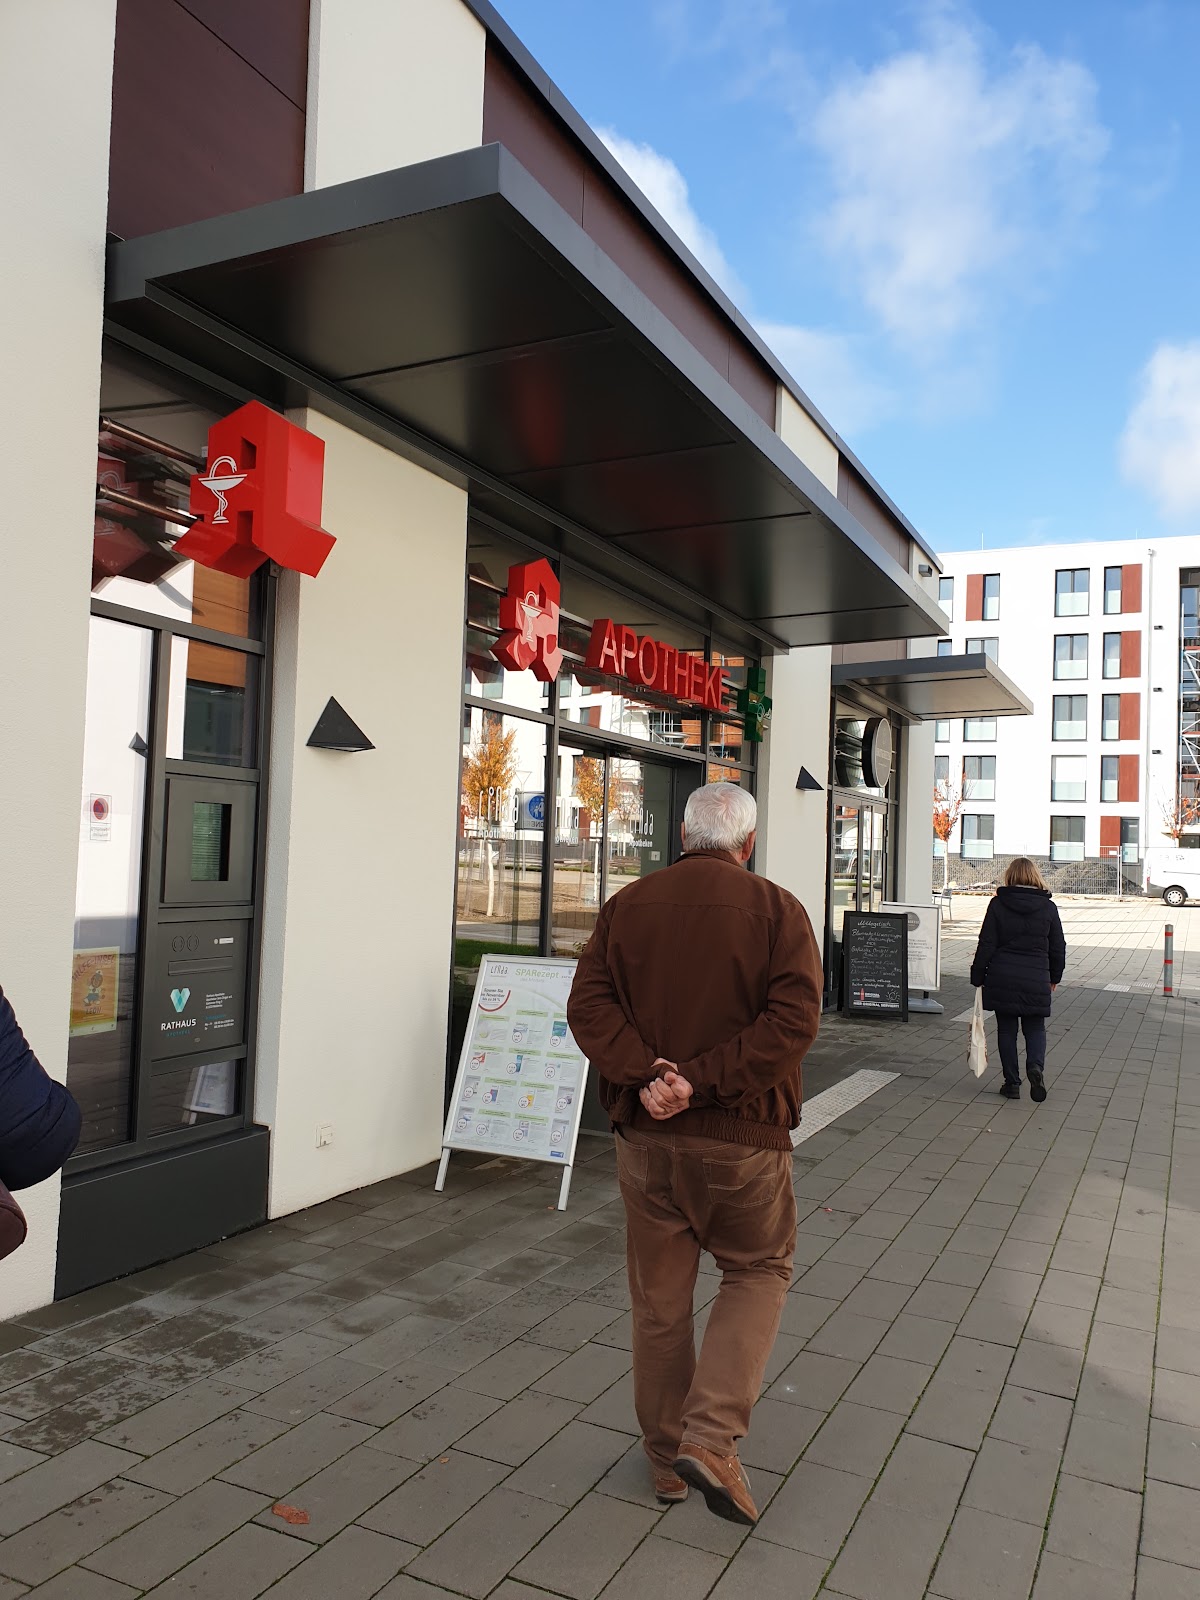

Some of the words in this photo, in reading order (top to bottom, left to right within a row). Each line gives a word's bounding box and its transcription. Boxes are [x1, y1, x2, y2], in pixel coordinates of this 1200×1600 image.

[588, 618, 731, 712] APOTHEKE
[515, 968, 560, 979] SPARezept
[160, 1018, 197, 1031] RATHAUS
